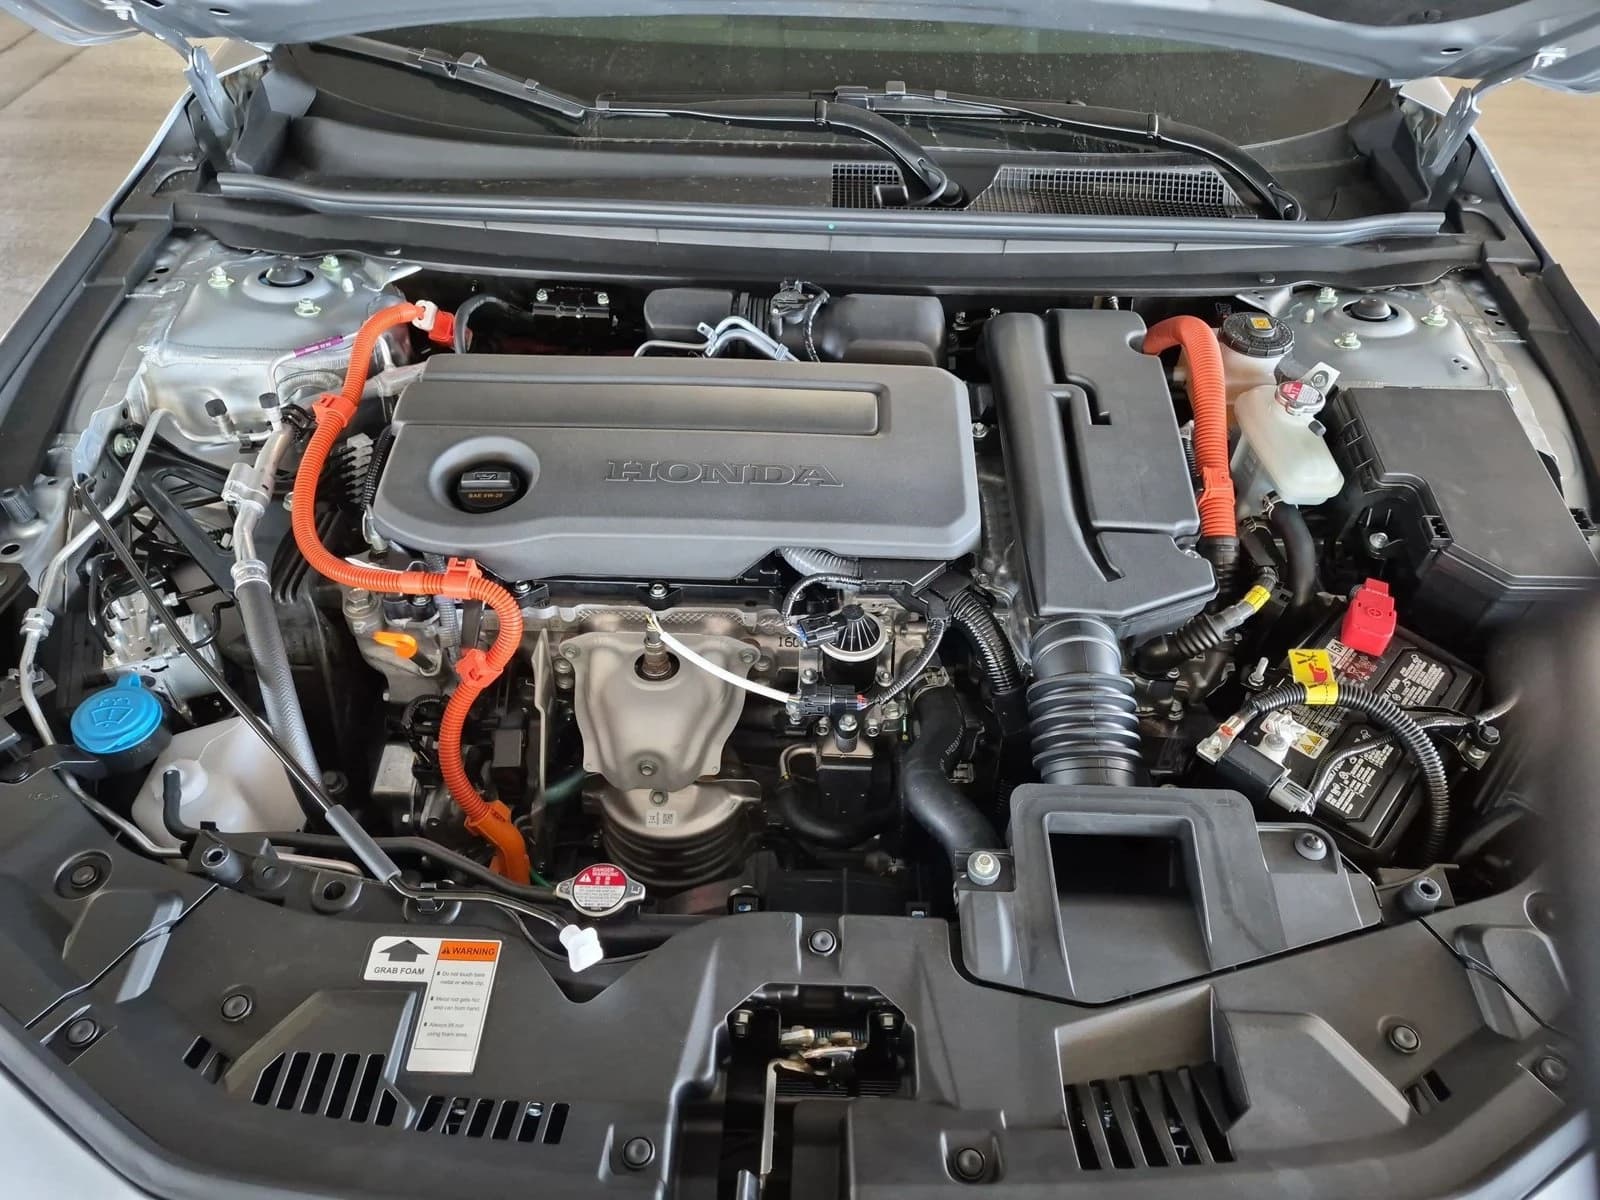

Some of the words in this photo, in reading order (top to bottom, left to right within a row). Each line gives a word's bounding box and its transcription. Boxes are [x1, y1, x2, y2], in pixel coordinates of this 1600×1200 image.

[605, 459, 844, 488] HONDA
[450, 947, 495, 956] WARNING
[374, 966, 398, 974] GRAB
[400, 967, 425, 975] FOAM
